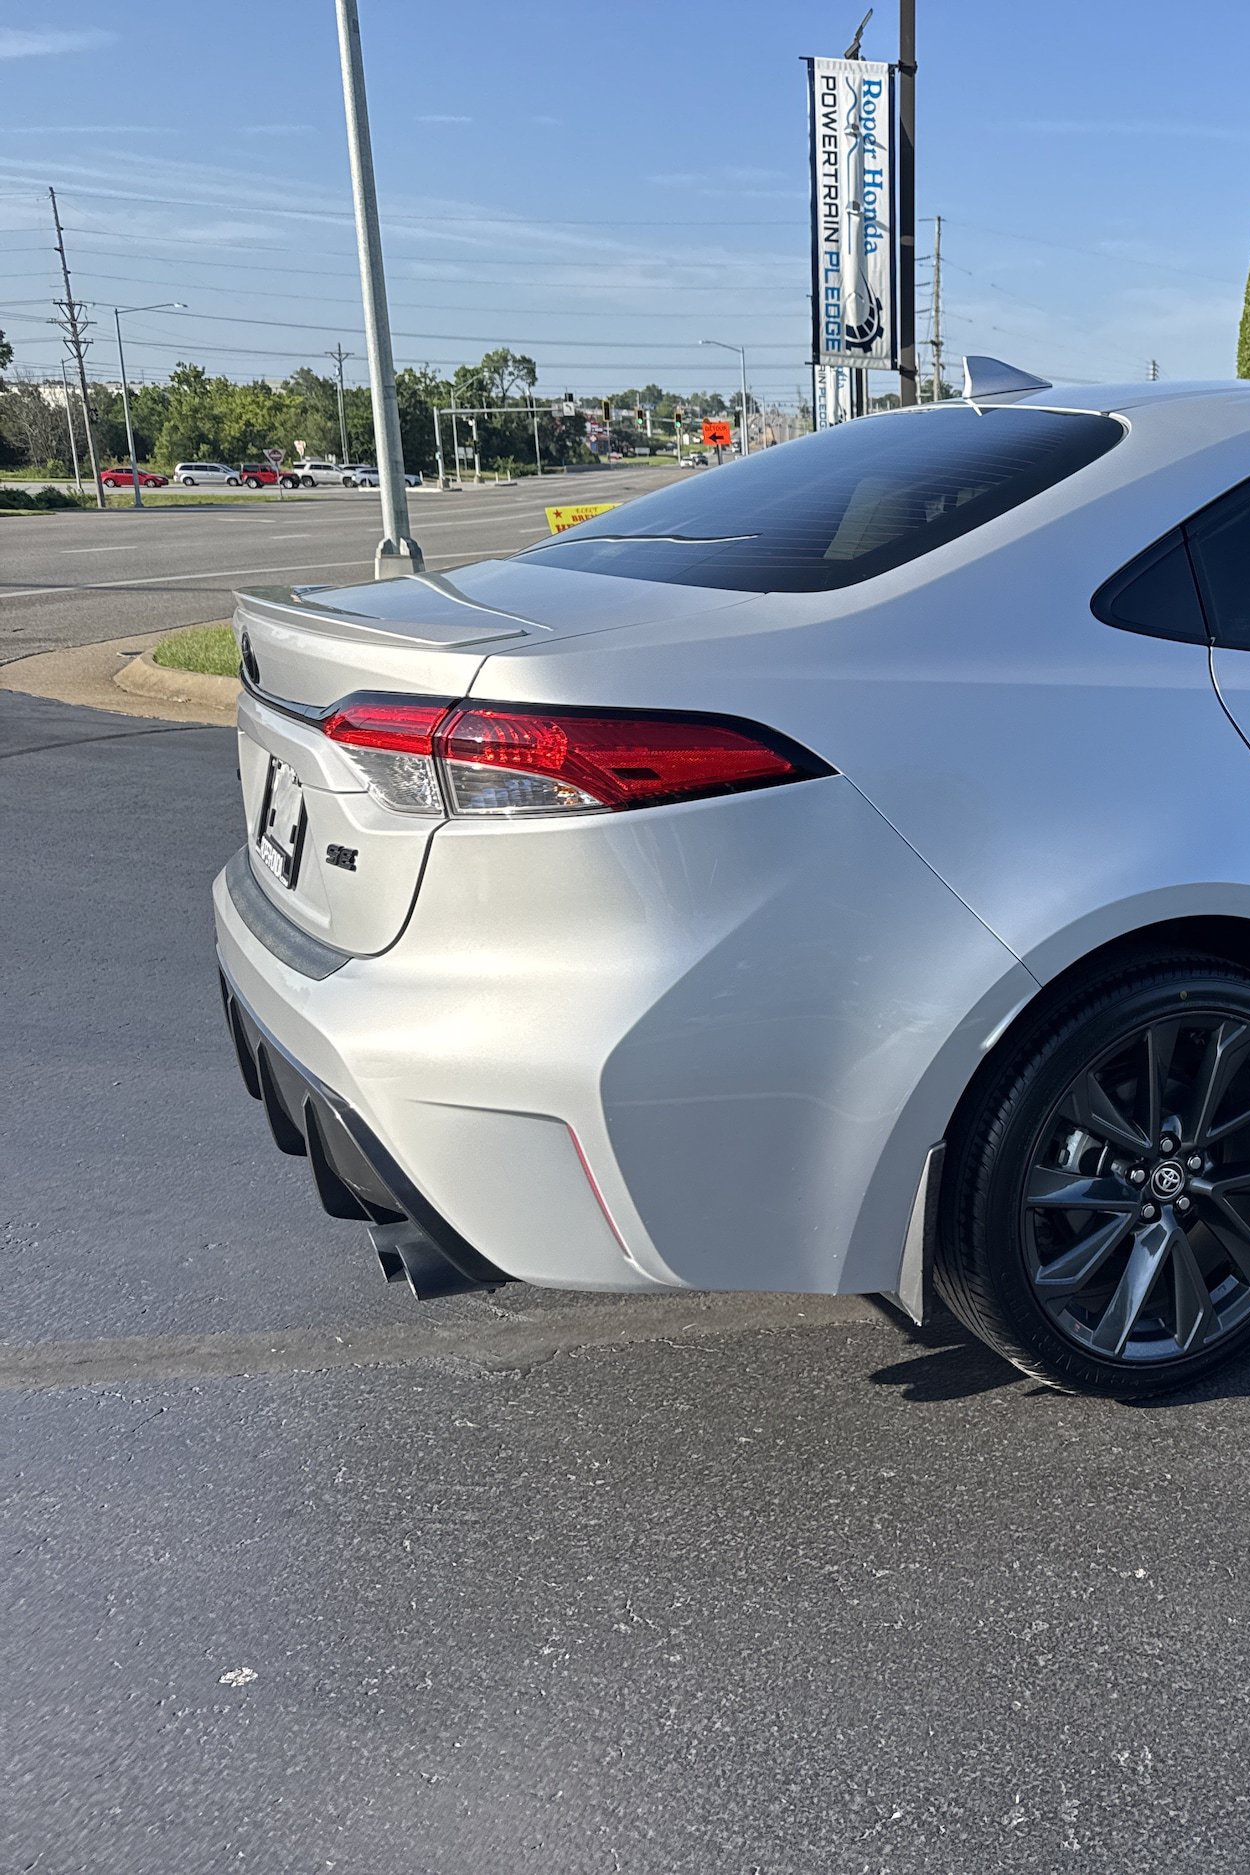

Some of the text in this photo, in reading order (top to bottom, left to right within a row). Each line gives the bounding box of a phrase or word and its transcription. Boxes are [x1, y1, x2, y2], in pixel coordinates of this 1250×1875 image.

[820, 75, 841, 353] POWERTRAIN PLEDGE
[859, 78, 884, 256] Roper Honda
[326, 844, 358, 872] SE
